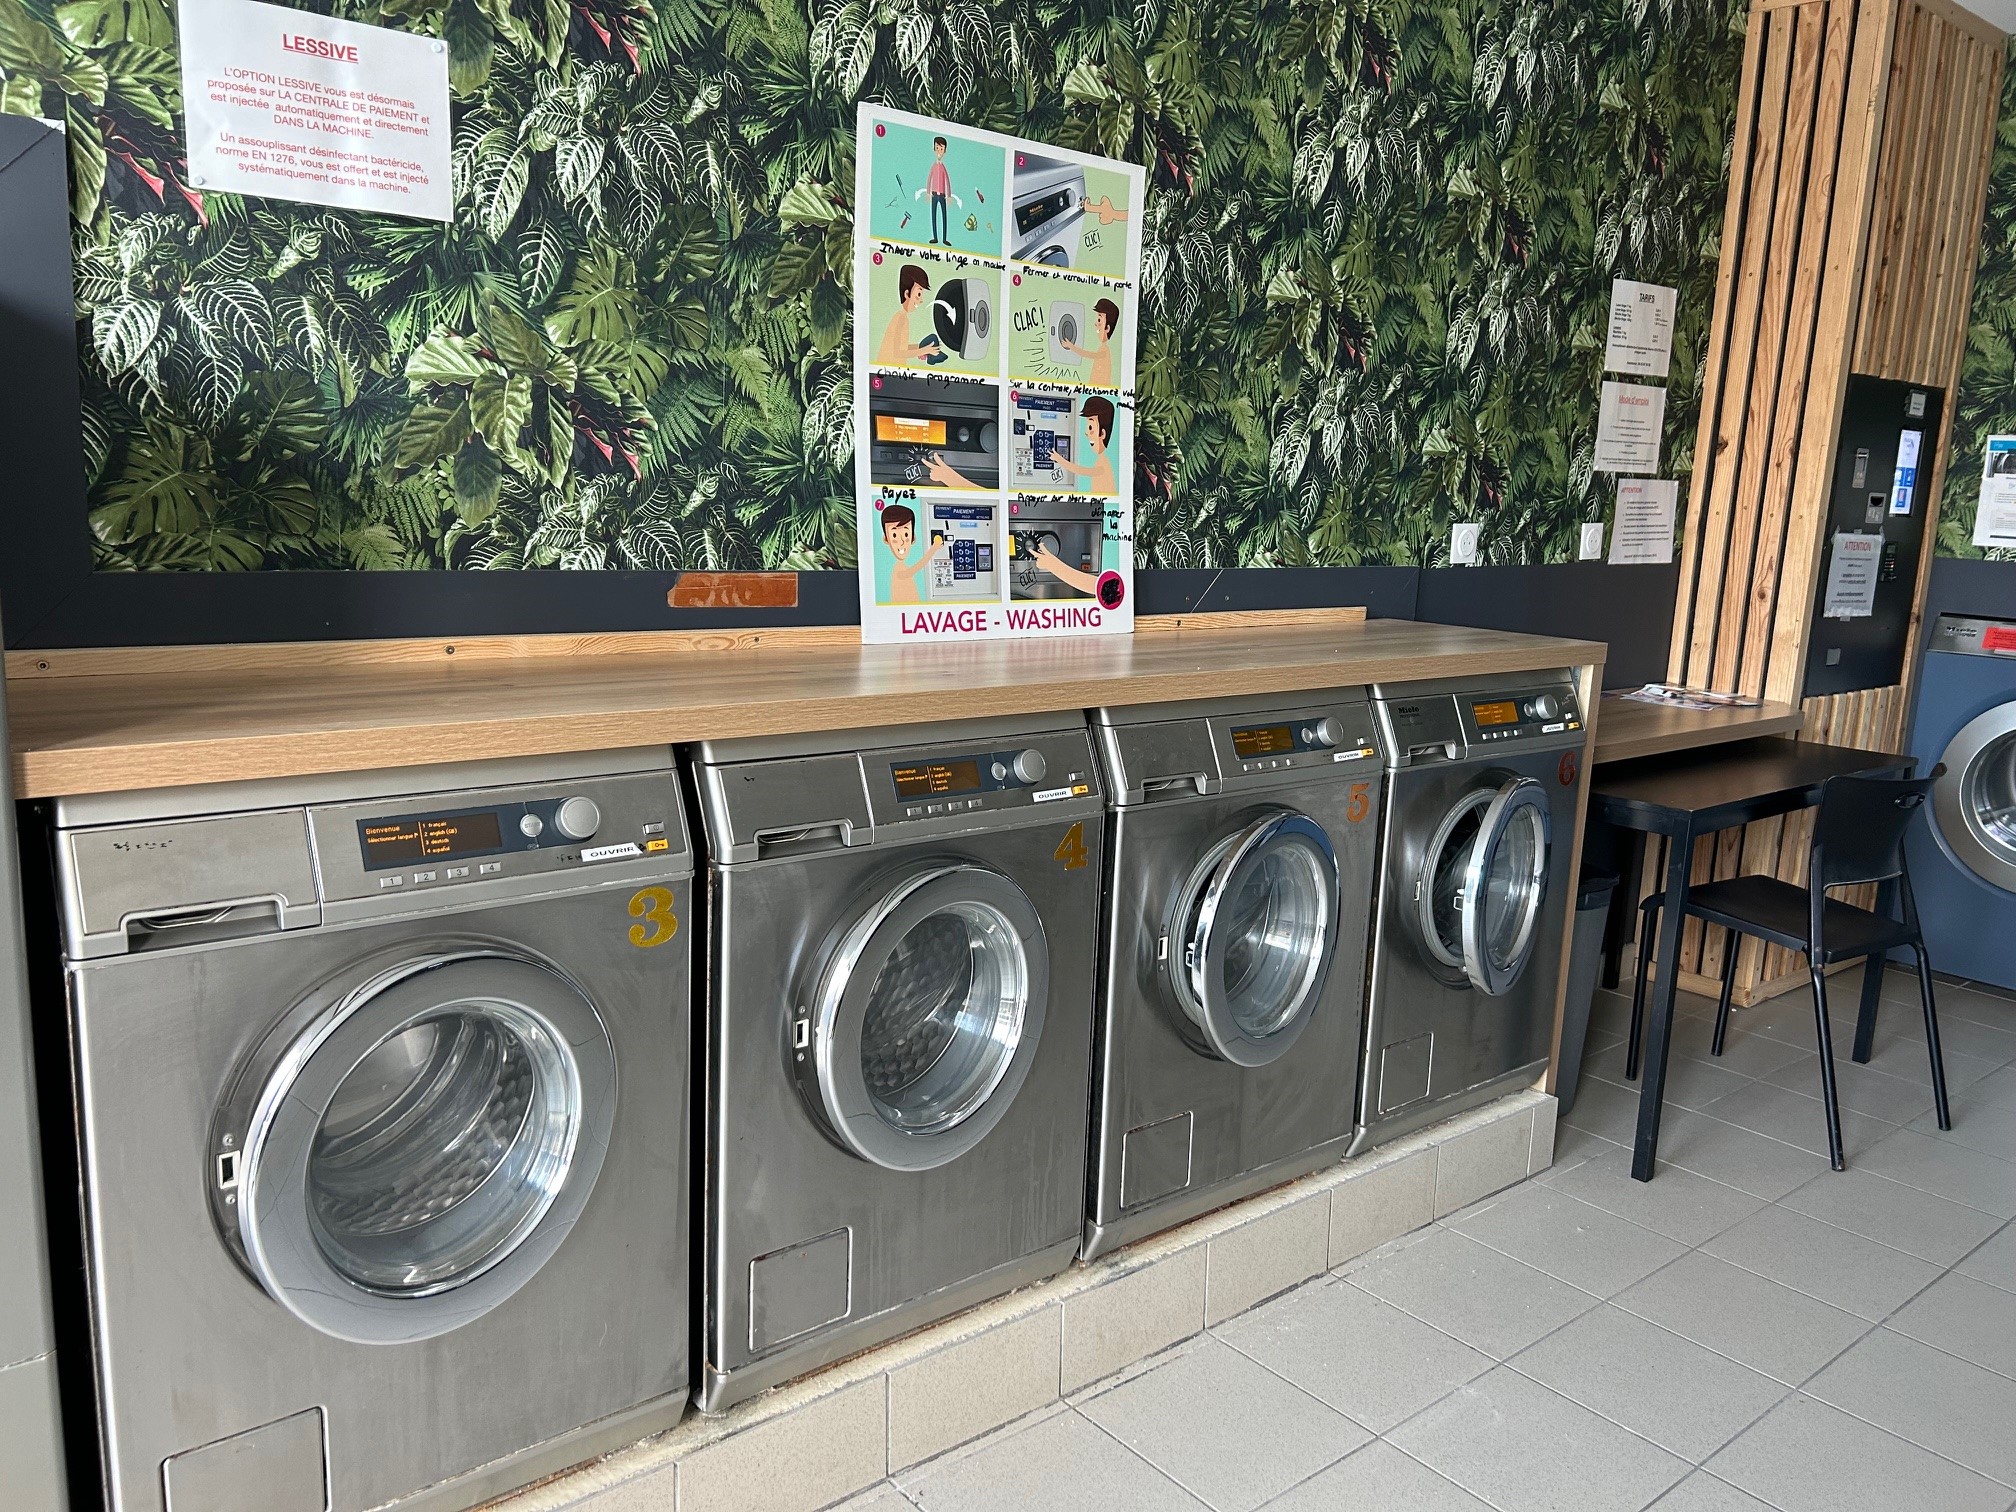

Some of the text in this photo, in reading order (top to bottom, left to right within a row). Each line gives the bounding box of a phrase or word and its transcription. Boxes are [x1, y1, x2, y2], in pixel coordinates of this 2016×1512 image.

[283, 33, 359, 62] LESSIVE
[225, 67, 415, 109] L'OPTION LESSIVE vous est désormais
[207, 79, 430, 124] proposée sur LA CENTRALE DE PAIEMENT et
[211, 93, 428, 136] est injectée automatiquement et directement
[274, 114, 374, 139] DANS LA MACHINE.
[216, 146, 429, 184] norme EN 1276, vous est offert et est injecté
[220, 132, 424, 172] Un assouplissant désinfectant bactéricide,
[238, 162, 411, 194] systématiquement dans la machine.
[920, 249, 941, 262] votre
[946, 251, 968, 271] linge
[1022, 265, 1049, 277] Fermer
[1063, 274, 1100, 285] verrouiller
[1103, 276, 1110, 287] la
[1114, 281, 1132, 292] porte
[1639, 292, 1655, 302] TARIFS
[927, 373, 985, 389] programme
[1027, 380, 1034, 389] la
[881, 486, 917, 505] Payez
[1109, 516, 1118, 530] la
[1843, 541, 1872, 551] ATTENTION
[901, 610, 987, 634] LAVAGE
[1005, 607, 1102, 630] WASHING
[1397, 706, 1420, 714] Miele
[1557, 750, 1577, 786] 6
[1038, 790, 1067, 799] OUVRIR
[1345, 782, 1370, 823] 5
[365, 825, 401, 835] Bienvenue
[397, 833, 414, 841] langue
[590, 846, 634, 858] OUVRIR
[1053, 820, 1089, 871] 4
[628, 885, 679, 948] 3
